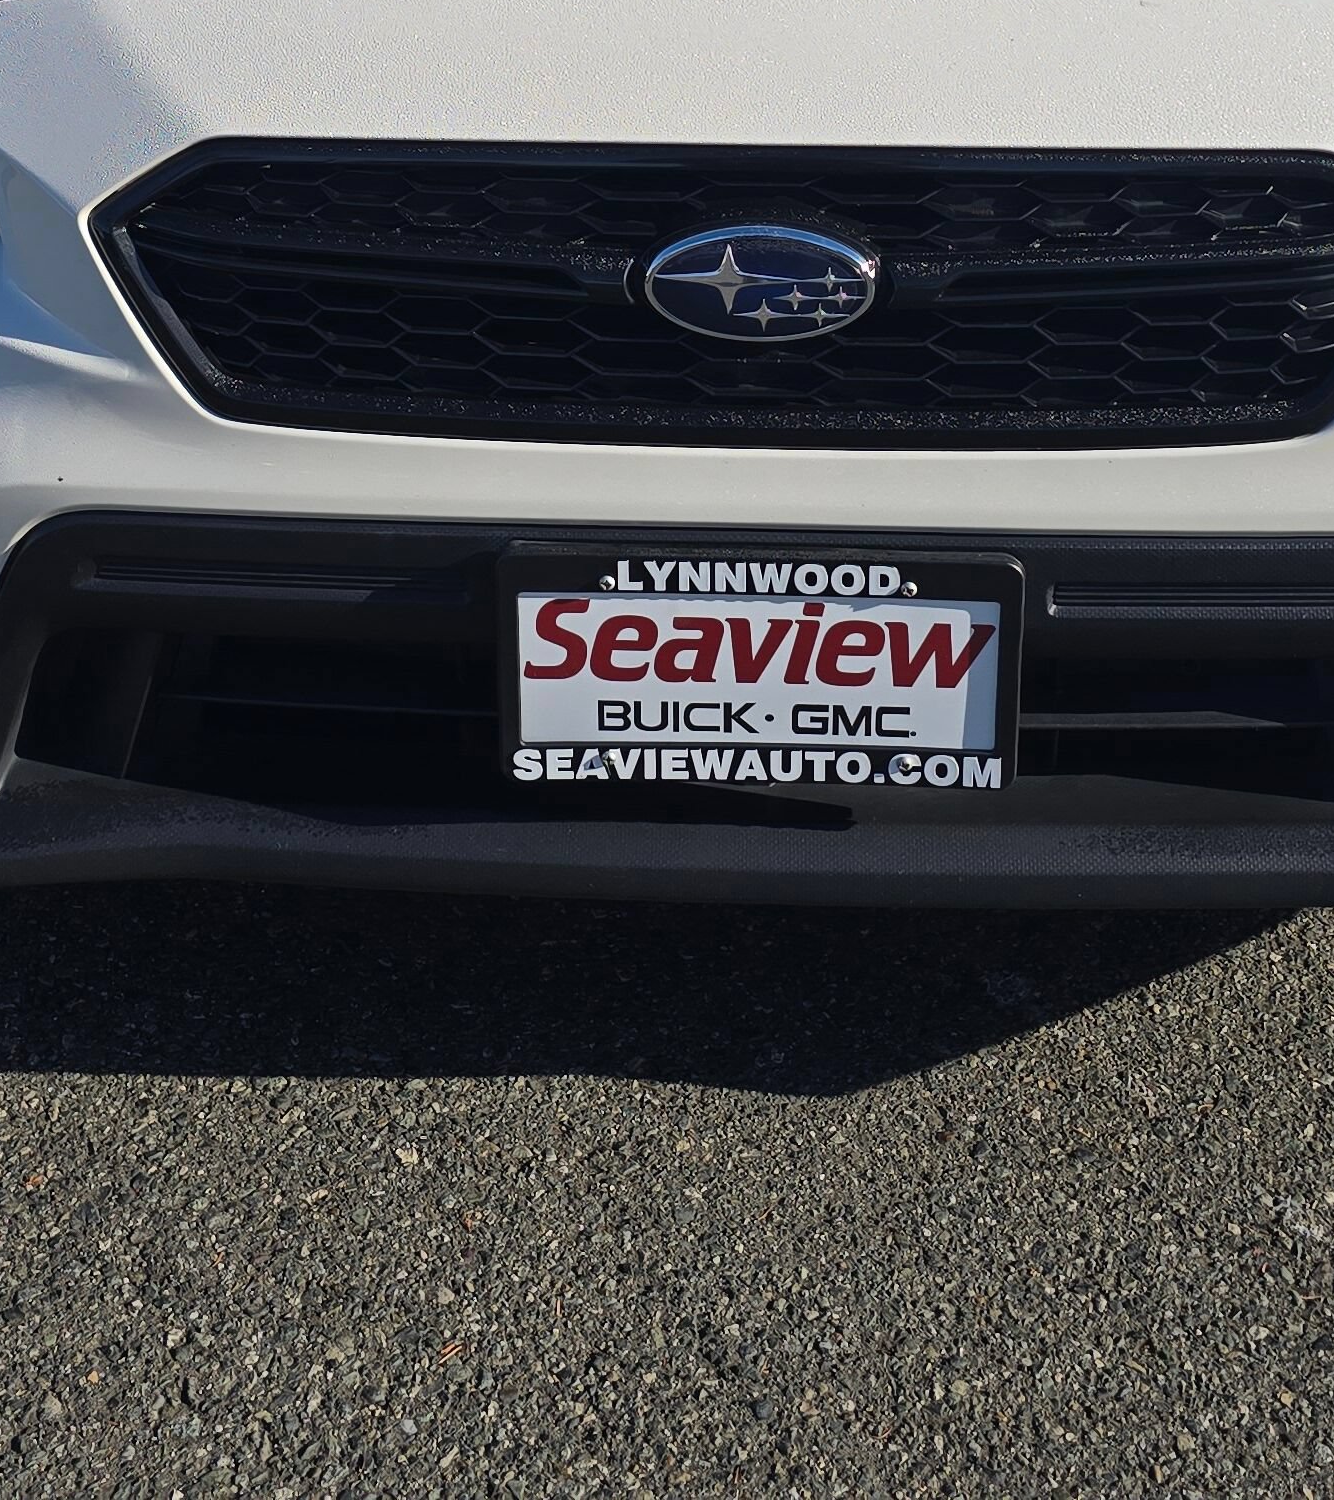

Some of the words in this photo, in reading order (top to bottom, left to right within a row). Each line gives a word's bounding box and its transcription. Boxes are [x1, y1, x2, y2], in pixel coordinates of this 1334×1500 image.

[617, 560, 901, 596] LYNNWOOD
[523, 598, 996, 688] Seaview
[597, 700, 760, 733] BUICK
[512, 748, 1002, 789] SEAVIEWAUTO.COM
